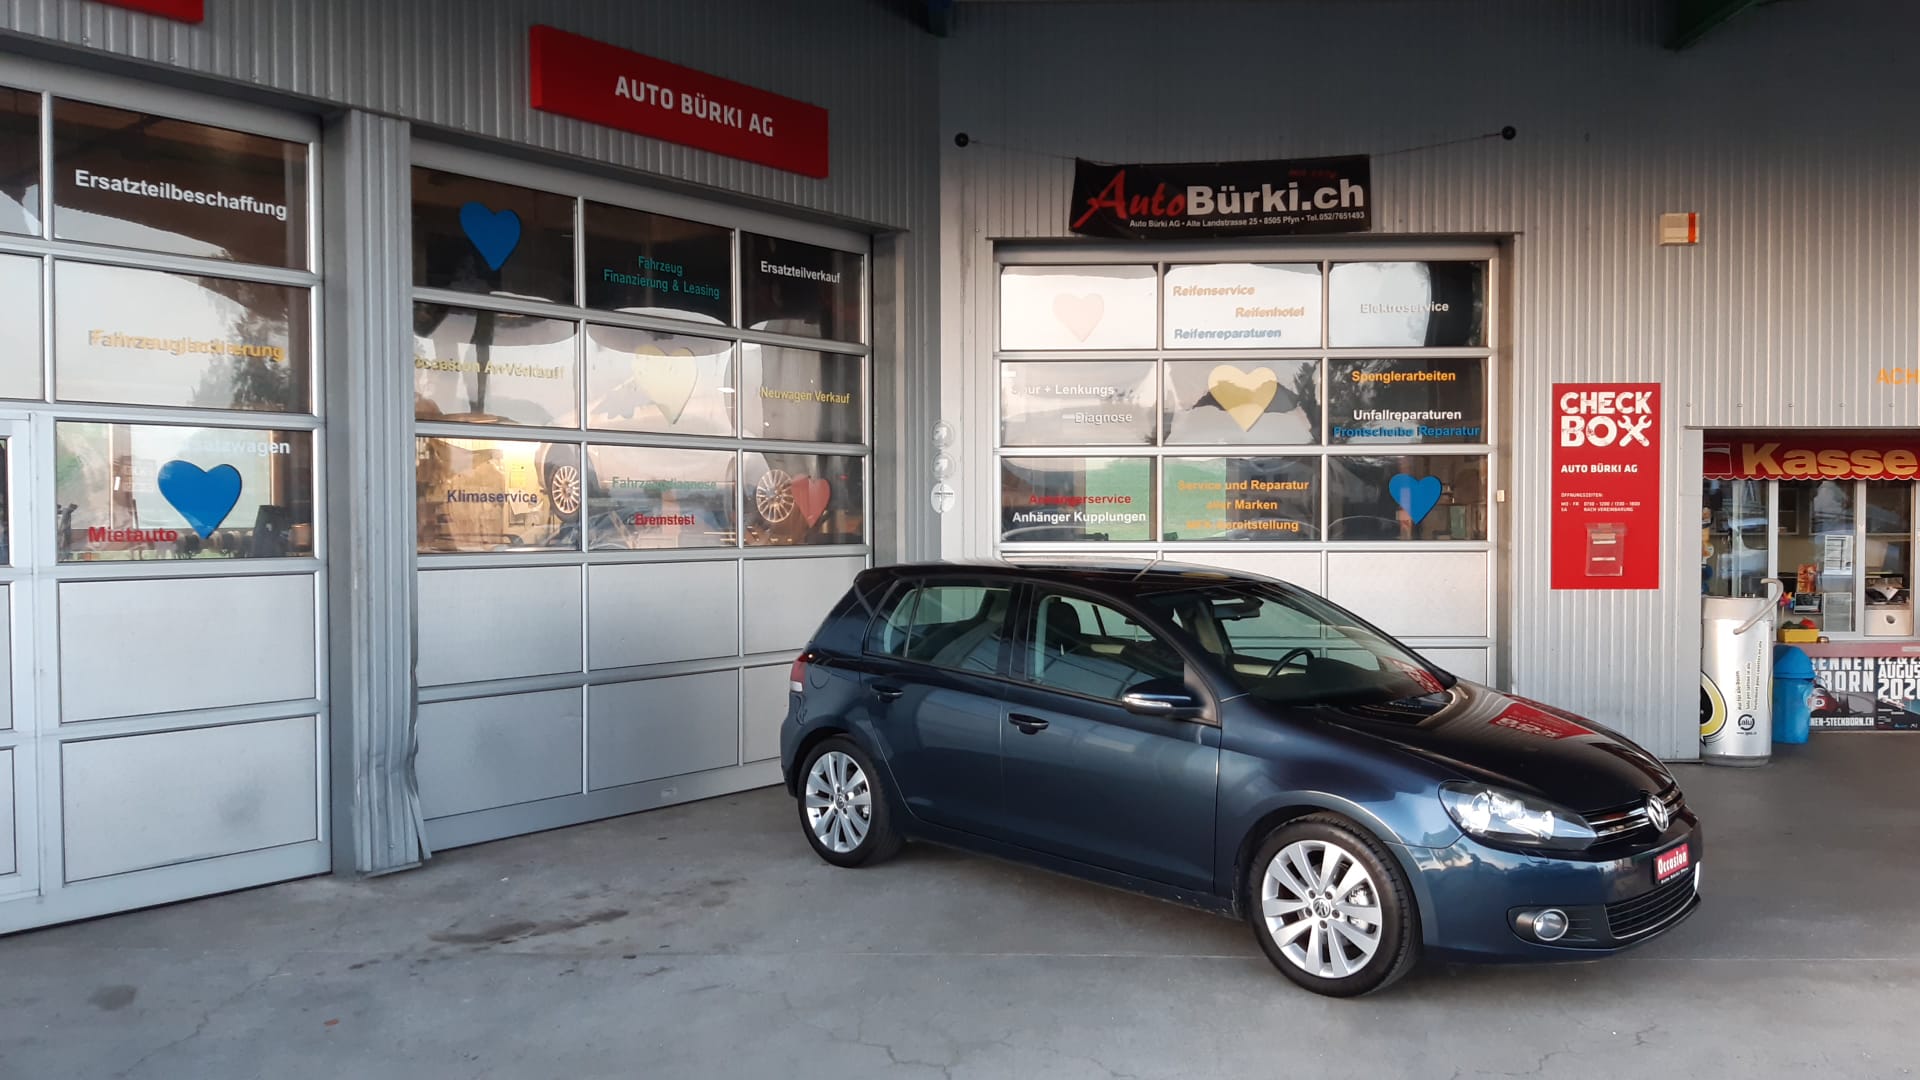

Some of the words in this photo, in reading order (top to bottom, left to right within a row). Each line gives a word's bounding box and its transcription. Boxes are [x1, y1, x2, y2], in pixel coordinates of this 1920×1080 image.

[614, 75, 674, 110] AUTO
[680, 92, 742, 129] BÜRKI
[748, 112, 774, 137] AG
[75, 169, 288, 221] Ersatzteilbeschaffung
[1129, 219, 1147, 228] Auto
[1148, 218, 1168, 227] Bürki
[1168, 218, 1181, 227] AG
[1202, 218, 1247, 227] Landstrasse
[1248, 217, 1258, 226] 25
[1282, 215, 1300, 225] Pfyn
[638, 255, 683, 278] Fahrzeug
[760, 260, 841, 284] Ersatzteilverkauf
[603, 268, 669, 293] Finanzierung
[672, 279, 680, 291] &
[683, 281, 720, 301] Leasing
[1173, 284, 1255, 297] Reifenservice
[1236, 306, 1305, 319] Reifenhotel
[1174, 327, 1282, 341] Reifenreparaturen
[1351, 370, 1456, 386] Spenglerarbeiten
[760, 386, 813, 401] Neuwagen
[814, 390, 851, 405] Verkauf
[1055, 383, 1115, 397] Lenkungs
[1559, 391, 1653, 415] CHECK
[1074, 411, 1133, 425] Diagnose
[1353, 408, 1462, 424] Unfallreparaturen
[1418, 425, 1481, 439] Reparatur
[1742, 442, 1918, 476] Kasse
[1560, 464, 1588, 473] AUTO
[1591, 463, 1622, 473] BÜRKI
[1624, 464, 1638, 473] AG
[1225, 480, 1247, 490] und
[1250, 480, 1309, 492] Reparatur
[447, 489, 538, 504] Klimaservice
[1234, 499, 1278, 510] Marken
[634, 513, 695, 526] Bremstest
[1012, 511, 1071, 524] Anhänger
[1073, 511, 1146, 524] Kupplungen
[88, 526, 178, 544] Mietauto
[1878, 678, 1920, 700] 202
[1657, 850, 1687, 875] Occasion
